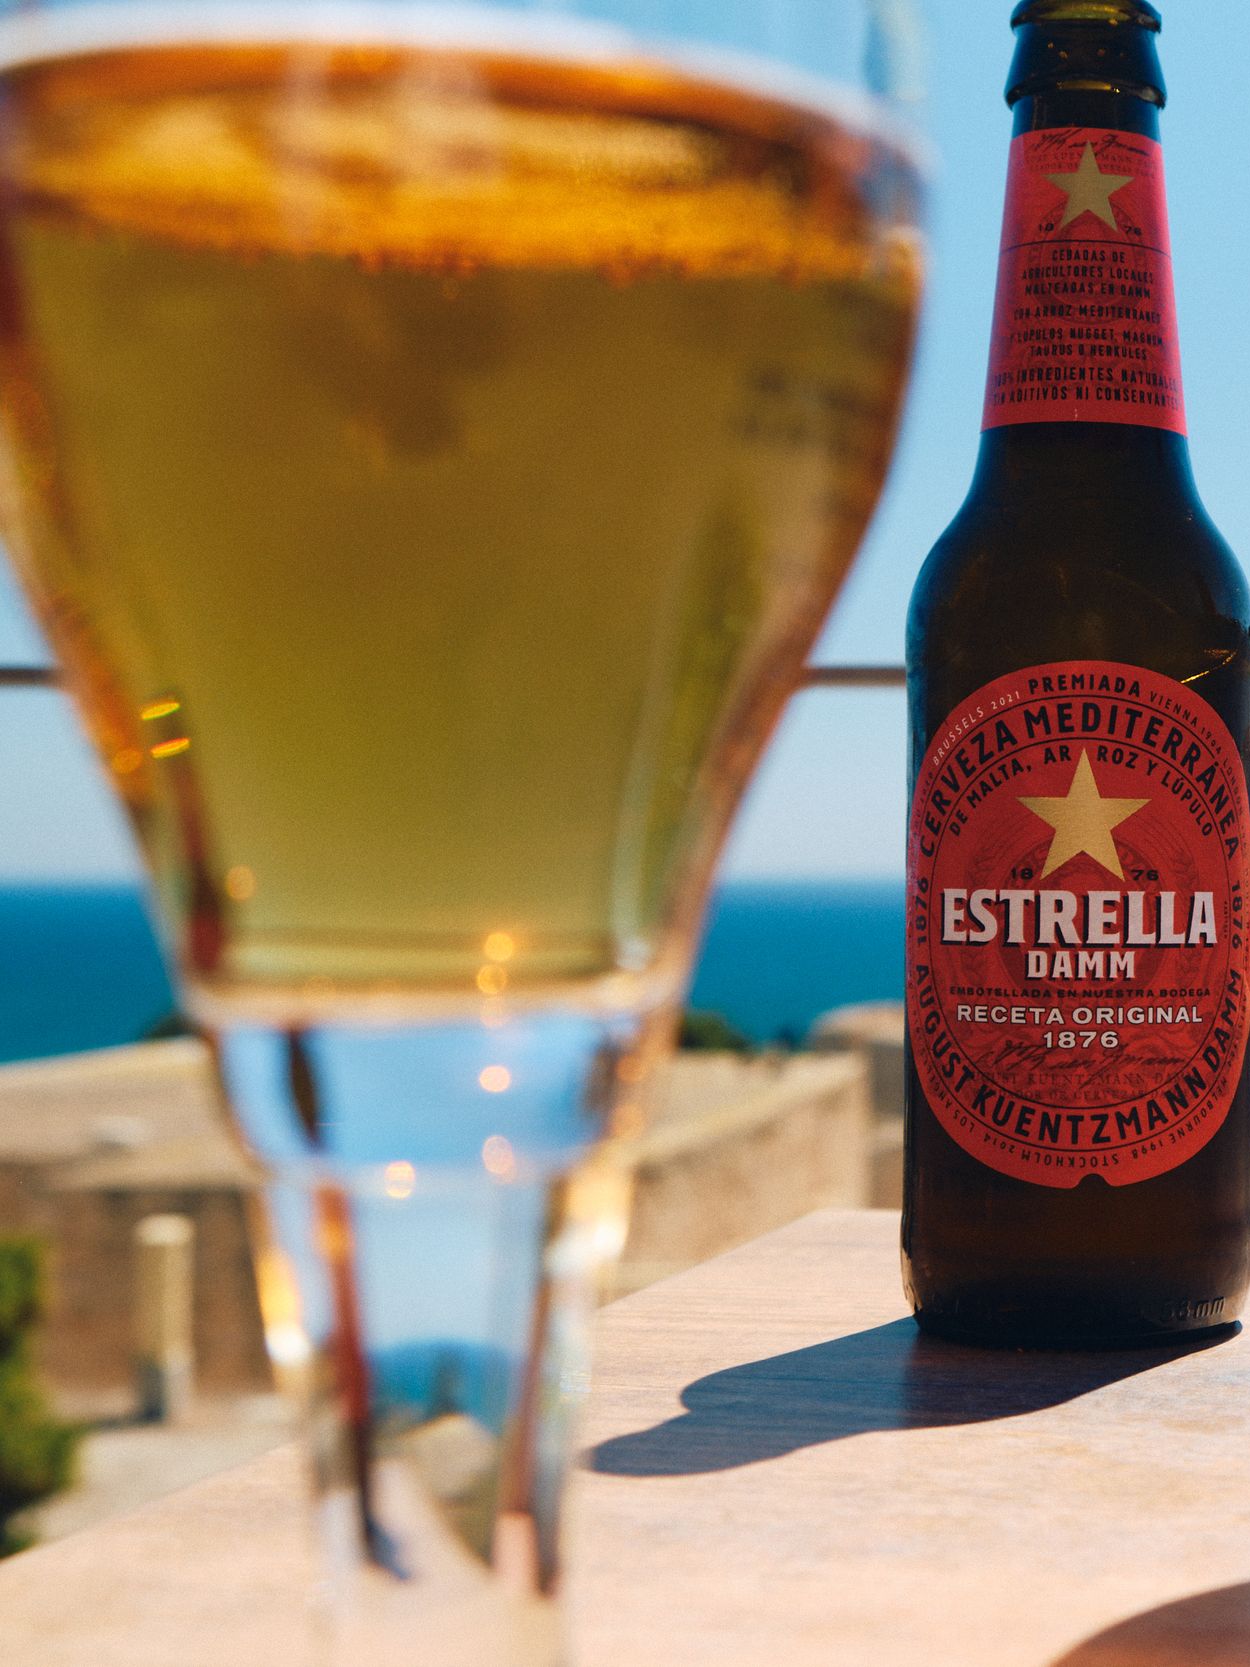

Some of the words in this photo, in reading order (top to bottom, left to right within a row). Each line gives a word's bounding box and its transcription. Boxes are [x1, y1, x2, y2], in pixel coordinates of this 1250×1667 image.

[1052, 249, 1106, 262] CEBADAS
[1112, 251, 1126, 263] DE
[1023, 266, 1103, 280] AGRICULTORES
[1110, 269, 1154, 284] LOCALES
[1025, 282, 1094, 296] MALTEADAS
[1101, 282, 1115, 295] EN
[1121, 284, 1151, 299] DAMM
[1035, 304, 1072, 318] ARROZ
[1030, 344, 1072, 358] TAURUS
[1090, 345, 1147, 361] HERKULES
[1017, 367, 1114, 382] INGREDIENTES
[1010, 386, 1067, 403] ADITIVOS
[1076, 387, 1089, 400] NI
[932, 706, 984, 766] BRUSSELS
[991, 690, 1020, 710] 2021
[1029, 674, 1141, 698] PREMIADA
[1150, 691, 1199, 728] VIENNA
[919, 720, 1018, 859] CERVEZA
[1024, 702, 1239, 861] MEDITERRÁNEA
[949, 810, 969, 837] DE
[966, 758, 1032, 808] MALTA,
[1147, 759, 1158, 777] Y
[1161, 770, 1214, 837] LÚPULO
[1011, 868, 1034, 881] 18
[1131, 869, 1159, 882] 76
[915, 876, 930, 947] 1876
[941, 888, 1218, 949] ESTRELLA
[1231, 880, 1243, 951] 1876
[1025, 950, 1136, 982] DAMM
[950, 985, 1051, 998] EMBOTELLADA
[1057, 987, 1077, 998] EN
[1082, 987, 1155, 998] NUESTRA
[1159, 986, 1212, 998] BODEGA
[957, 1003, 1065, 1025] RECETA
[1071, 1004, 1204, 1025] ORIGINAL
[1043, 1031, 1120, 1050] 1876
[916, 964, 976, 1093] AUGUST
[972, 1067, 1207, 1145] KUENTZMANN
[1202, 969, 1242, 1073] DAMM
[1169, 1078, 1228, 1145] MELBOURNE
[983, 1132, 1016, 1153] 2014
[1131, 1139, 1163, 1160] 1998
[1020, 1149, 1119, 1169] STOCKHOLM
